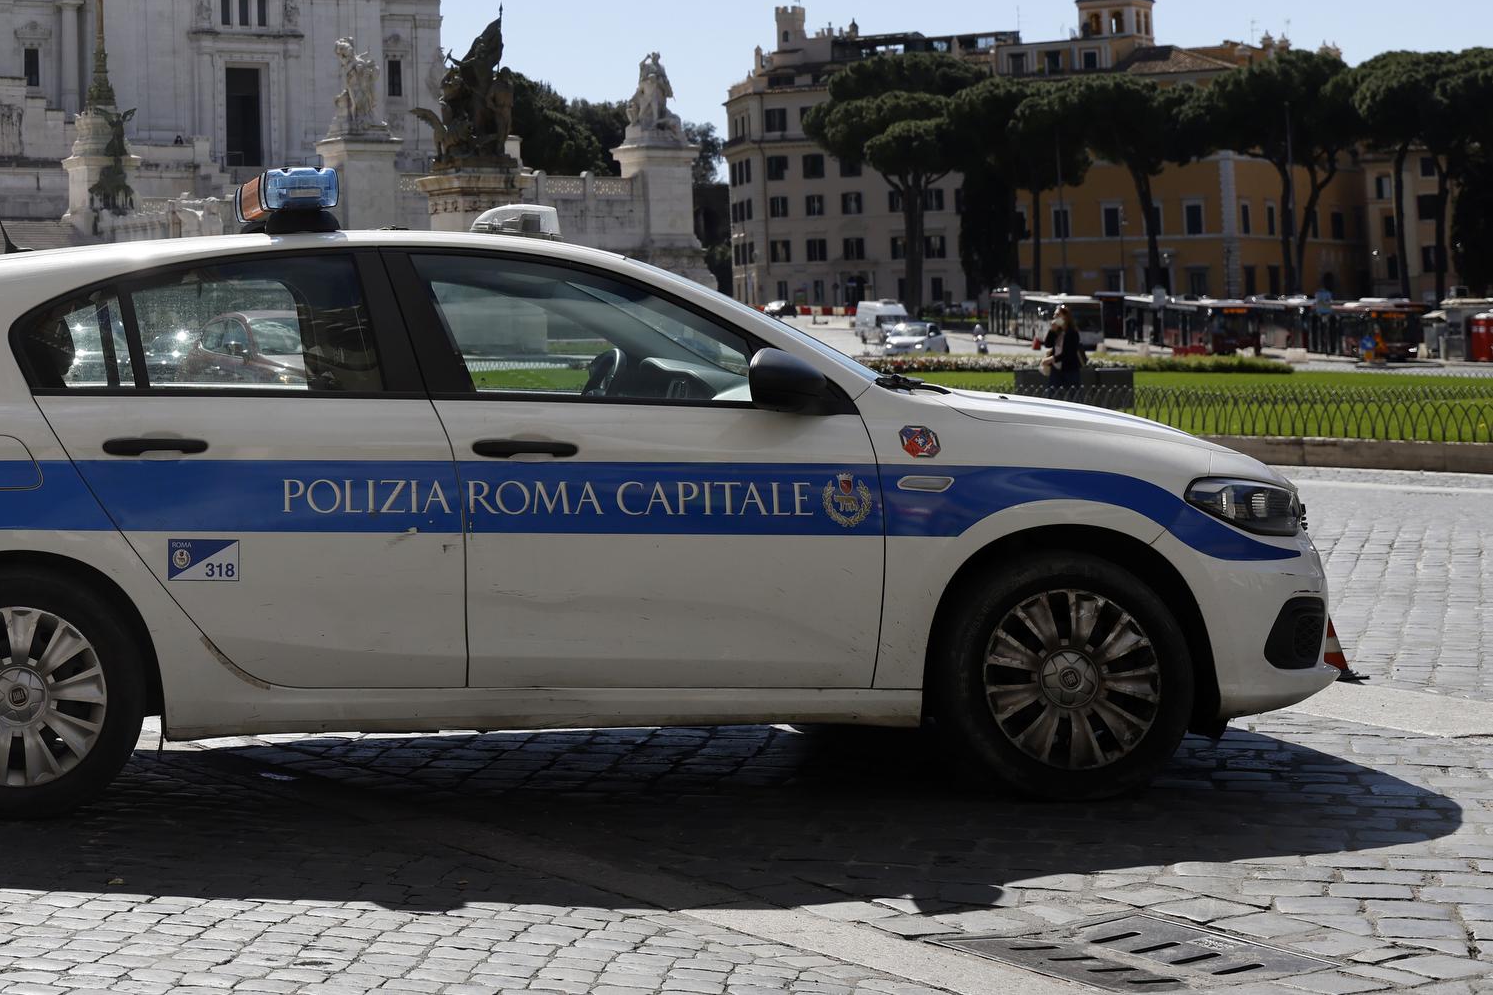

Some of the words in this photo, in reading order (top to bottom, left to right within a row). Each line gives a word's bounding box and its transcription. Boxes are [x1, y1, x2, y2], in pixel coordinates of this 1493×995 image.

[283, 478, 453, 514] POLIZIA
[468, 479, 604, 516] ROMA
[616, 480, 814, 517] CAPITALE
[205, 563, 235, 577] 318
